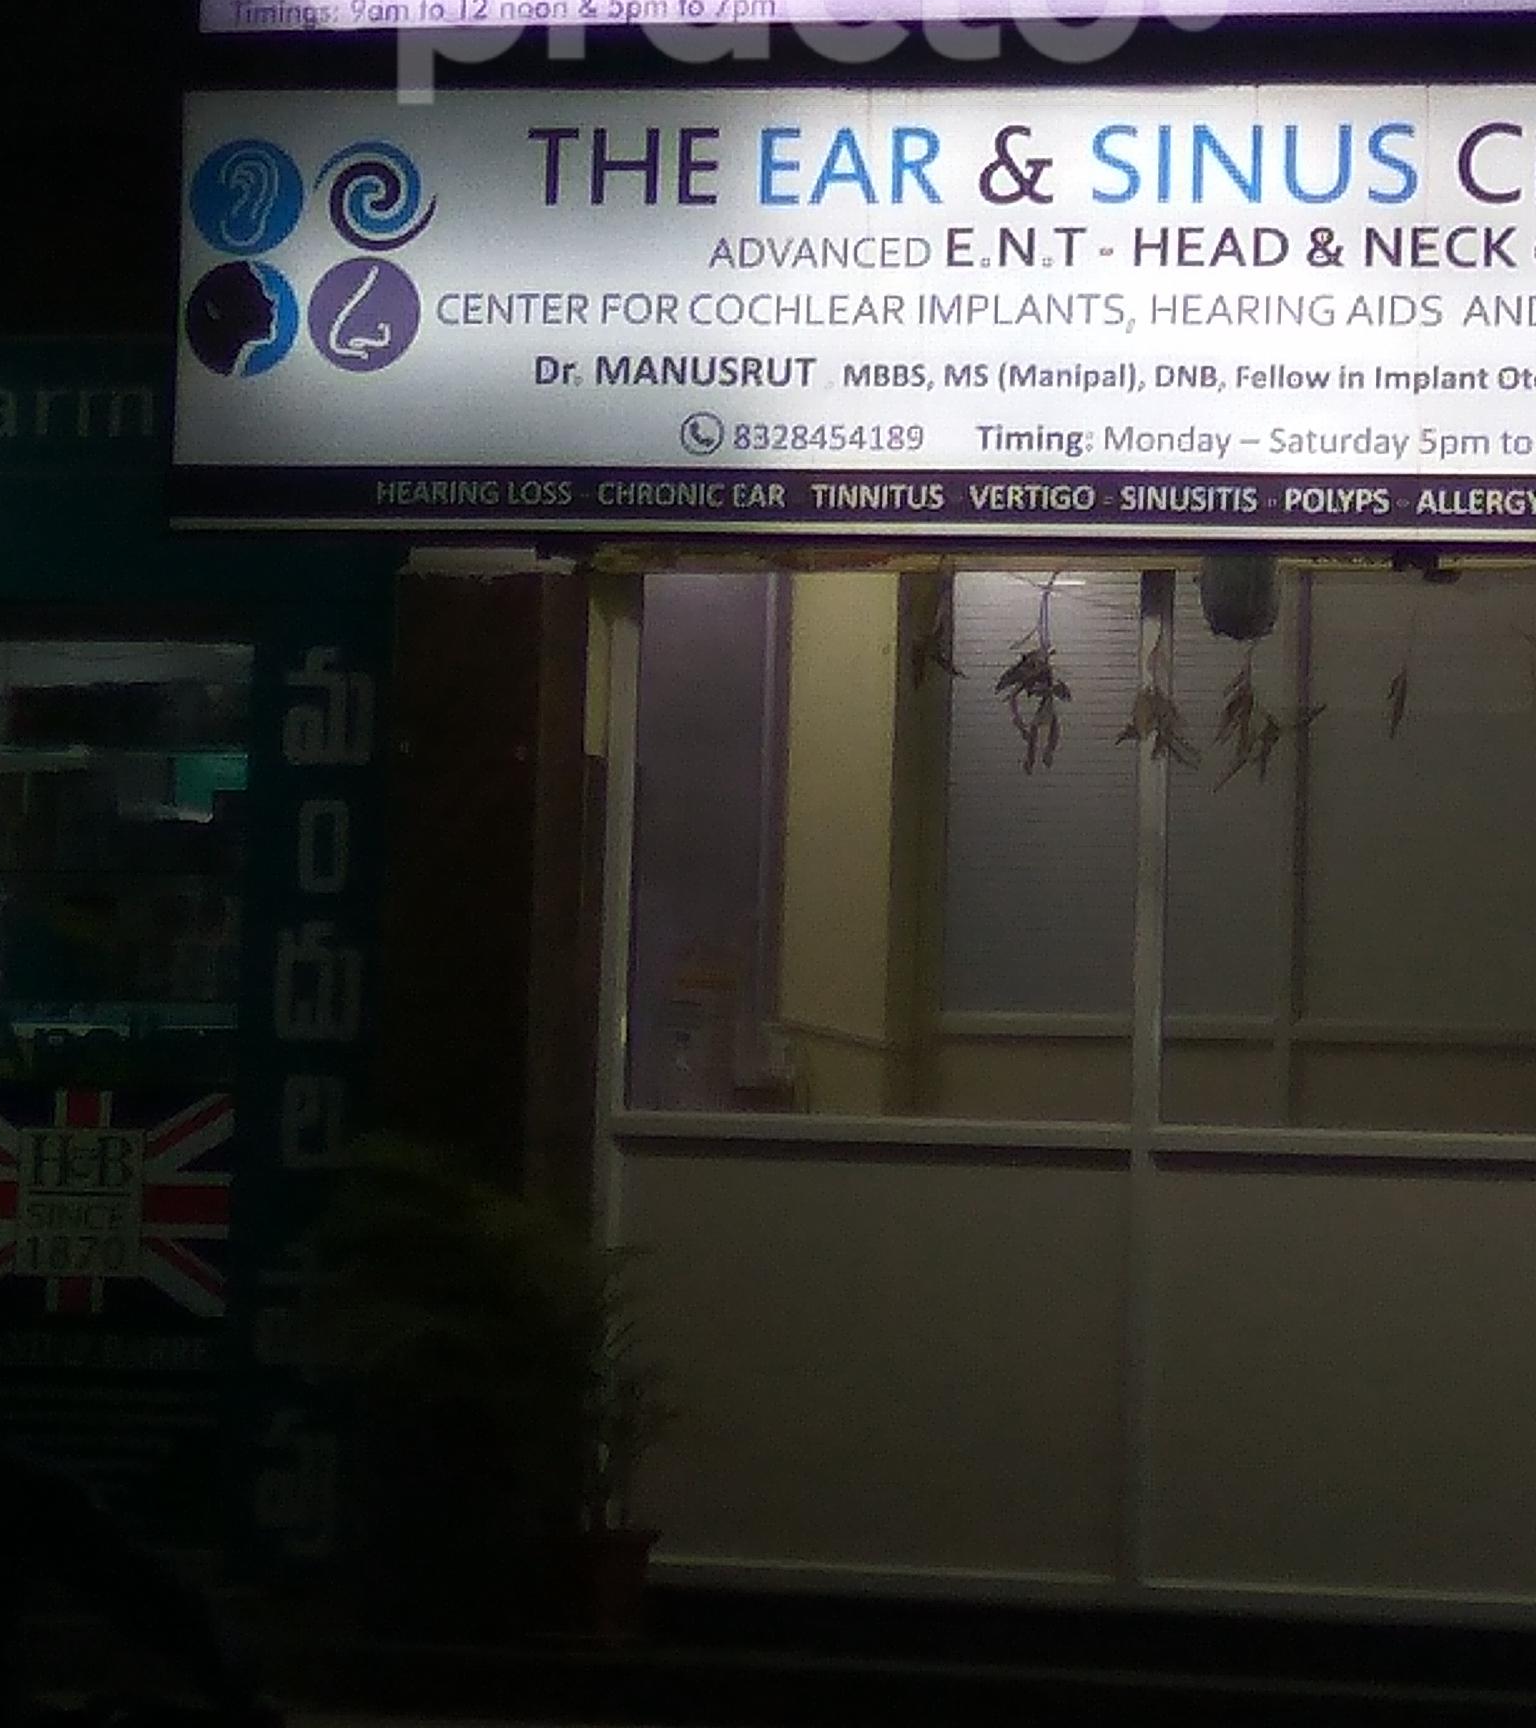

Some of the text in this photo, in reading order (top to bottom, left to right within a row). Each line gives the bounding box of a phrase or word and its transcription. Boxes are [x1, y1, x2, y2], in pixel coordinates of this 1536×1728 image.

[230, 0, 341, 32] Timings:
[527, 126, 721, 206] THE
[758, 126, 944, 206] EAR
[978, 124, 1055, 206] &
[1090, 122, 1419, 206] SINUS
[707, 237, 931, 270] ADVANCED
[1133, 226, 1290, 269] HEAD
[1306, 226, 1346, 269] &
[1364, 226, 1518, 269] NECK
[436, 292, 589, 325] CENTER
[602, 292, 678, 325] FOR
[689, 292, 906, 326] COCHLEAR
[918, 292, 1137, 334] IMPLANTS,
[1150, 293, 1336, 328] HEARING
[1346, 293, 1445, 328] AIDS
[534, 354, 584, 388] Dr.
[842, 362, 936, 392] MBBS,
[944, 363, 988, 389] MS
[997, 362, 1145, 394] (Manipal),
[1154, 365, 1227, 393] DNB,
[1235, 363, 1330, 391] Fellow
[1338, 365, 1366, 391] in
[1375, 364, 1489, 397] Implant
[733, 423, 925, 452] 8328454189
[975, 423, 1095, 458] Timing:
[1104, 427, 1230, 459] Monday
[1268, 427, 1410, 459] Saturday
[1417, 429, 1490, 459] 5pm
[1500, 431, 1534, 456] to
[376, 480, 501, 507] HEARING
[506, 480, 574, 507] LOSS
[596, 481, 725, 509] CHRONIC
[731, 482, 787, 509] EAR
[810, 483, 946, 511] TINNITUS
[968, 484, 1097, 512] VERTIGO
[1119, 485, 1260, 513] SINUSITIS
[1283, 487, 1392, 515] POLYPS
